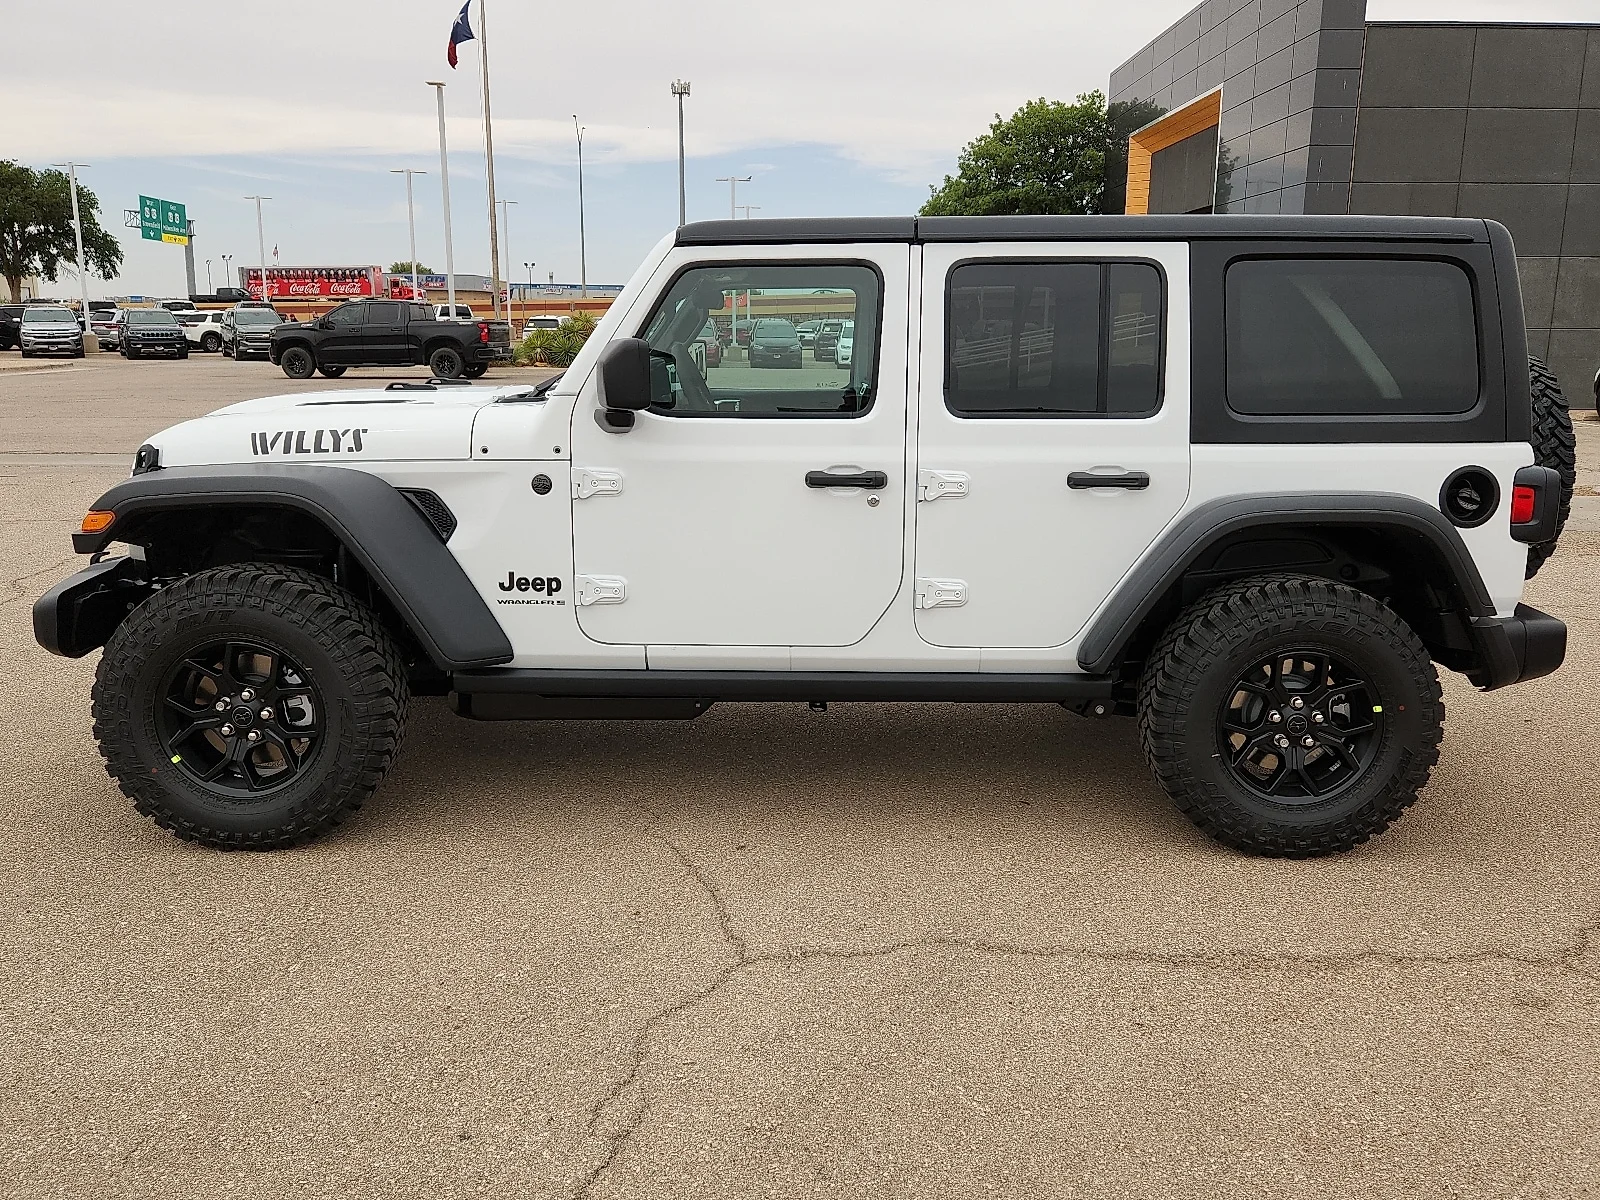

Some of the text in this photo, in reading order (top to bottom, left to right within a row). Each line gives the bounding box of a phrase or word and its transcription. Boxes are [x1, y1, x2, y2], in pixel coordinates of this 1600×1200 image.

[251, 429, 368, 455] WILLYS
[499, 571, 562, 596] Jeep
[1226, 618, 1371, 662] FALKEN
